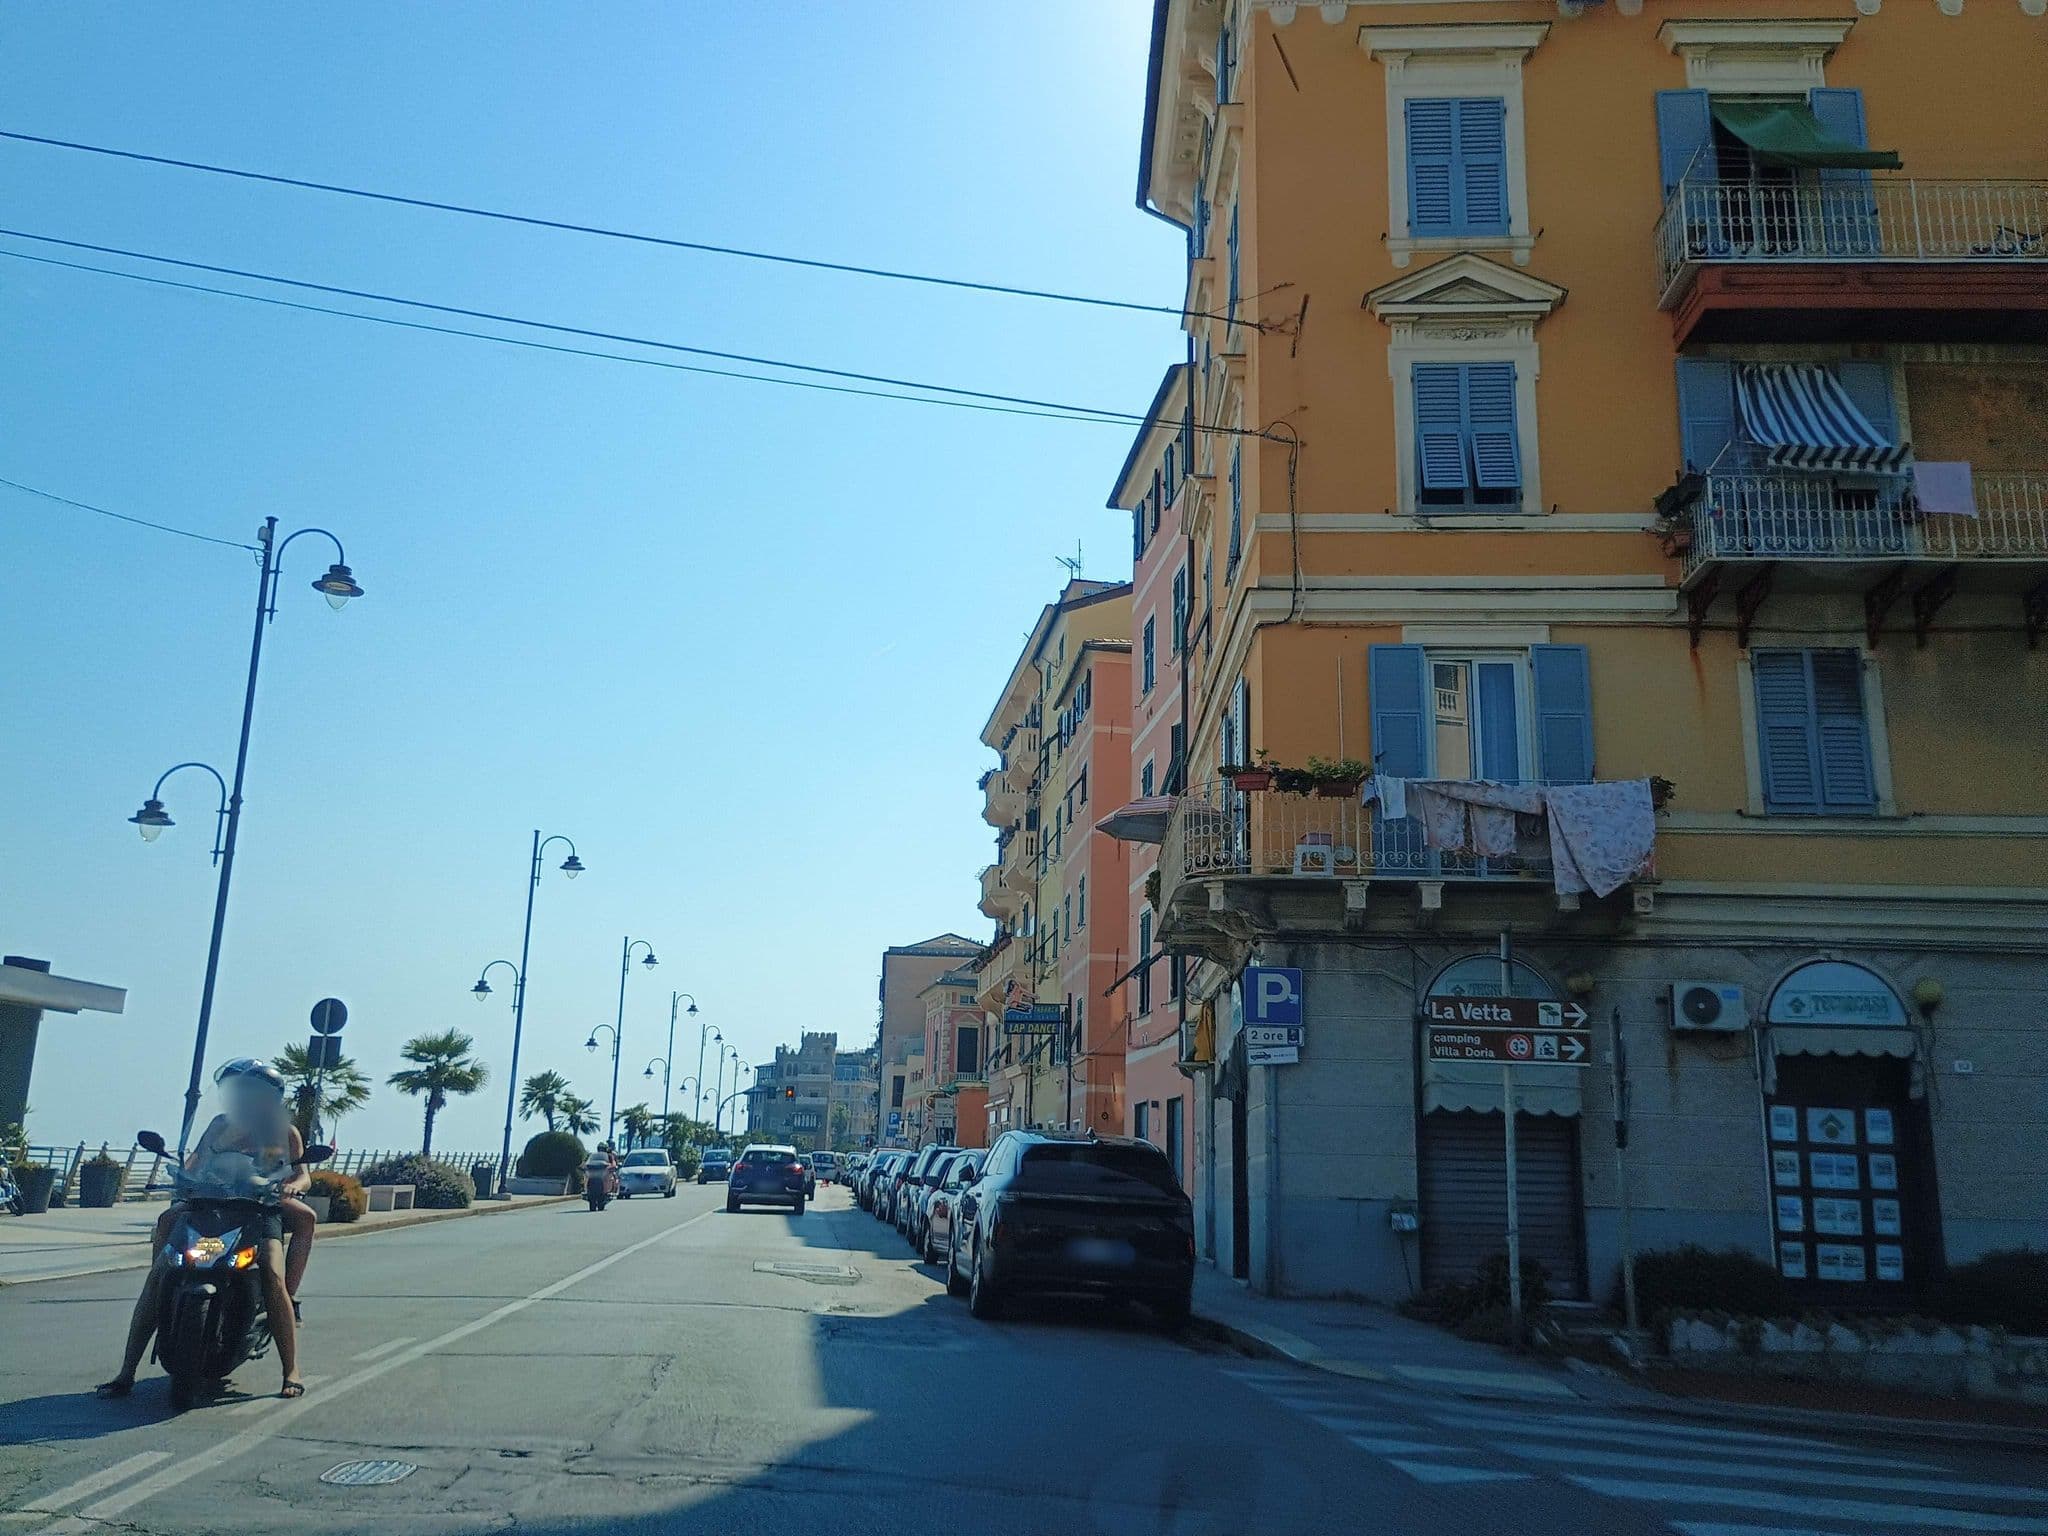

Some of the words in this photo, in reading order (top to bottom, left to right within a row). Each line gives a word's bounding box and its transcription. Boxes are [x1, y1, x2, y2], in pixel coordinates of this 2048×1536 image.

[1257, 972, 1291, 1018] P
[1431, 1001, 1456, 1020] La
[1458, 1002, 1512, 1022] Vetta
[1008, 1023, 1025, 1033] LAP
[1028, 1023, 1057, 1033] DANCE
[1251, 1030, 1259, 1040] 2
[1263, 1032, 1284, 1041] ore
[1433, 1033, 1481, 1045] camping
[1433, 1046, 1460, 1057] Villa
[1465, 1047, 1496, 1058] Doria
